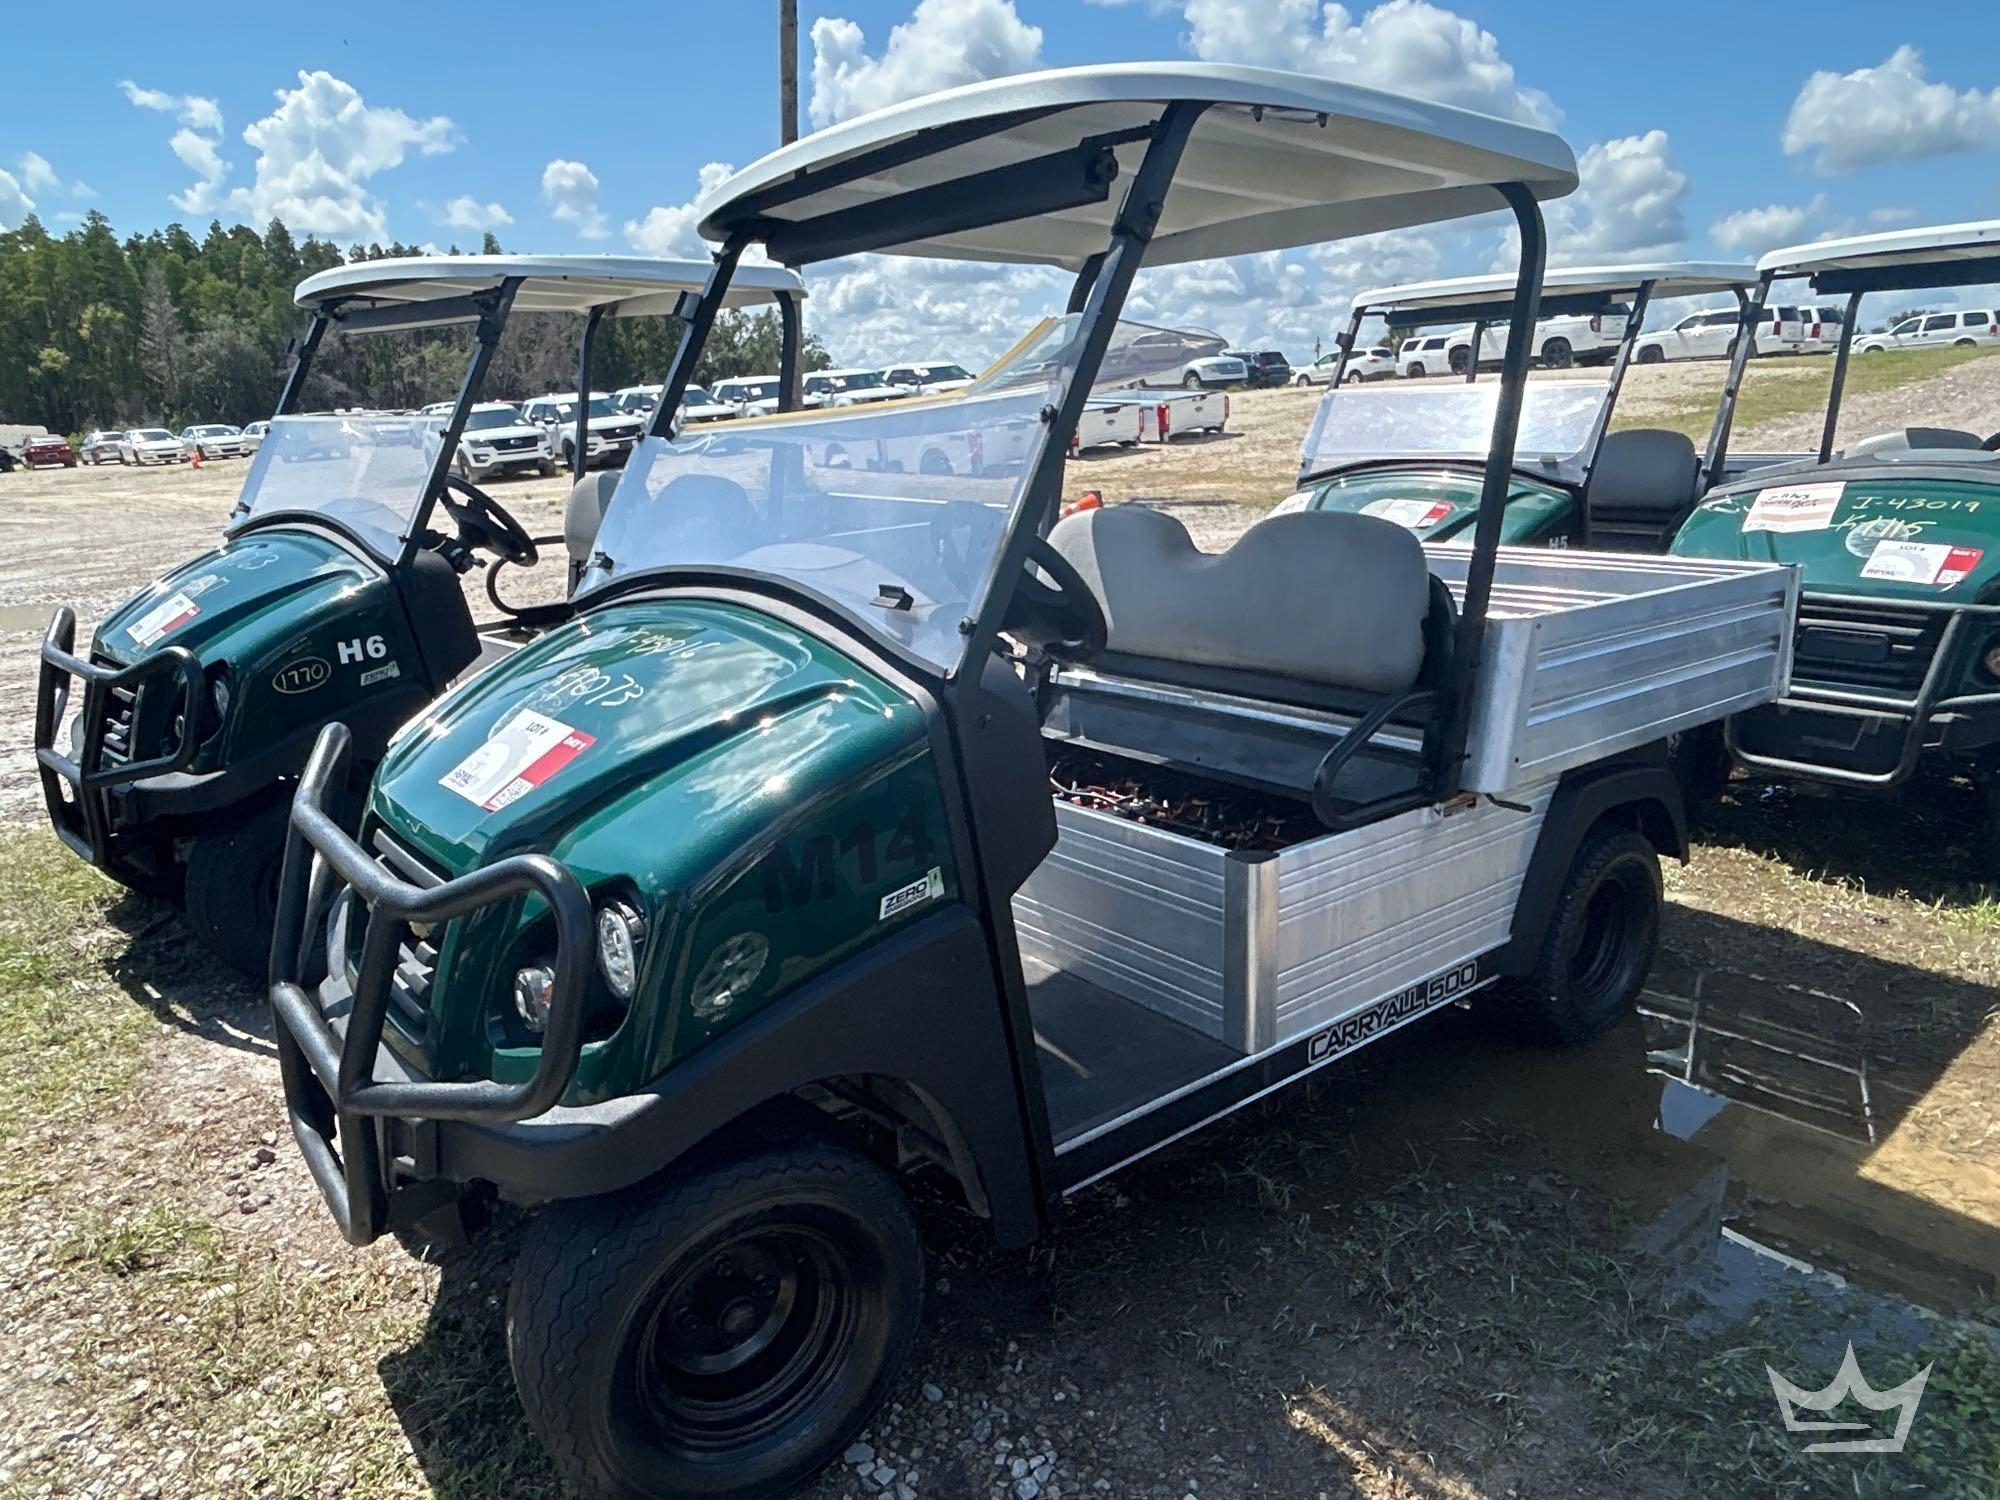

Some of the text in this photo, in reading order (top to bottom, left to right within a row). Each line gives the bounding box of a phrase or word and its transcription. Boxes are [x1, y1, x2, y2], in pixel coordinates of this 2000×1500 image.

[1852, 496, 1980, 512] I-43019
[1549, 535, 1569, 549] H5
[337, 635, 387, 664] H6
[281, 663, 324, 690] 1770
[525, 721, 545, 735] LOT
[763, 804, 935, 914] M14
[885, 880, 928, 909] ZERO
[1308, 960, 1477, 1064] CARRYALL 500
